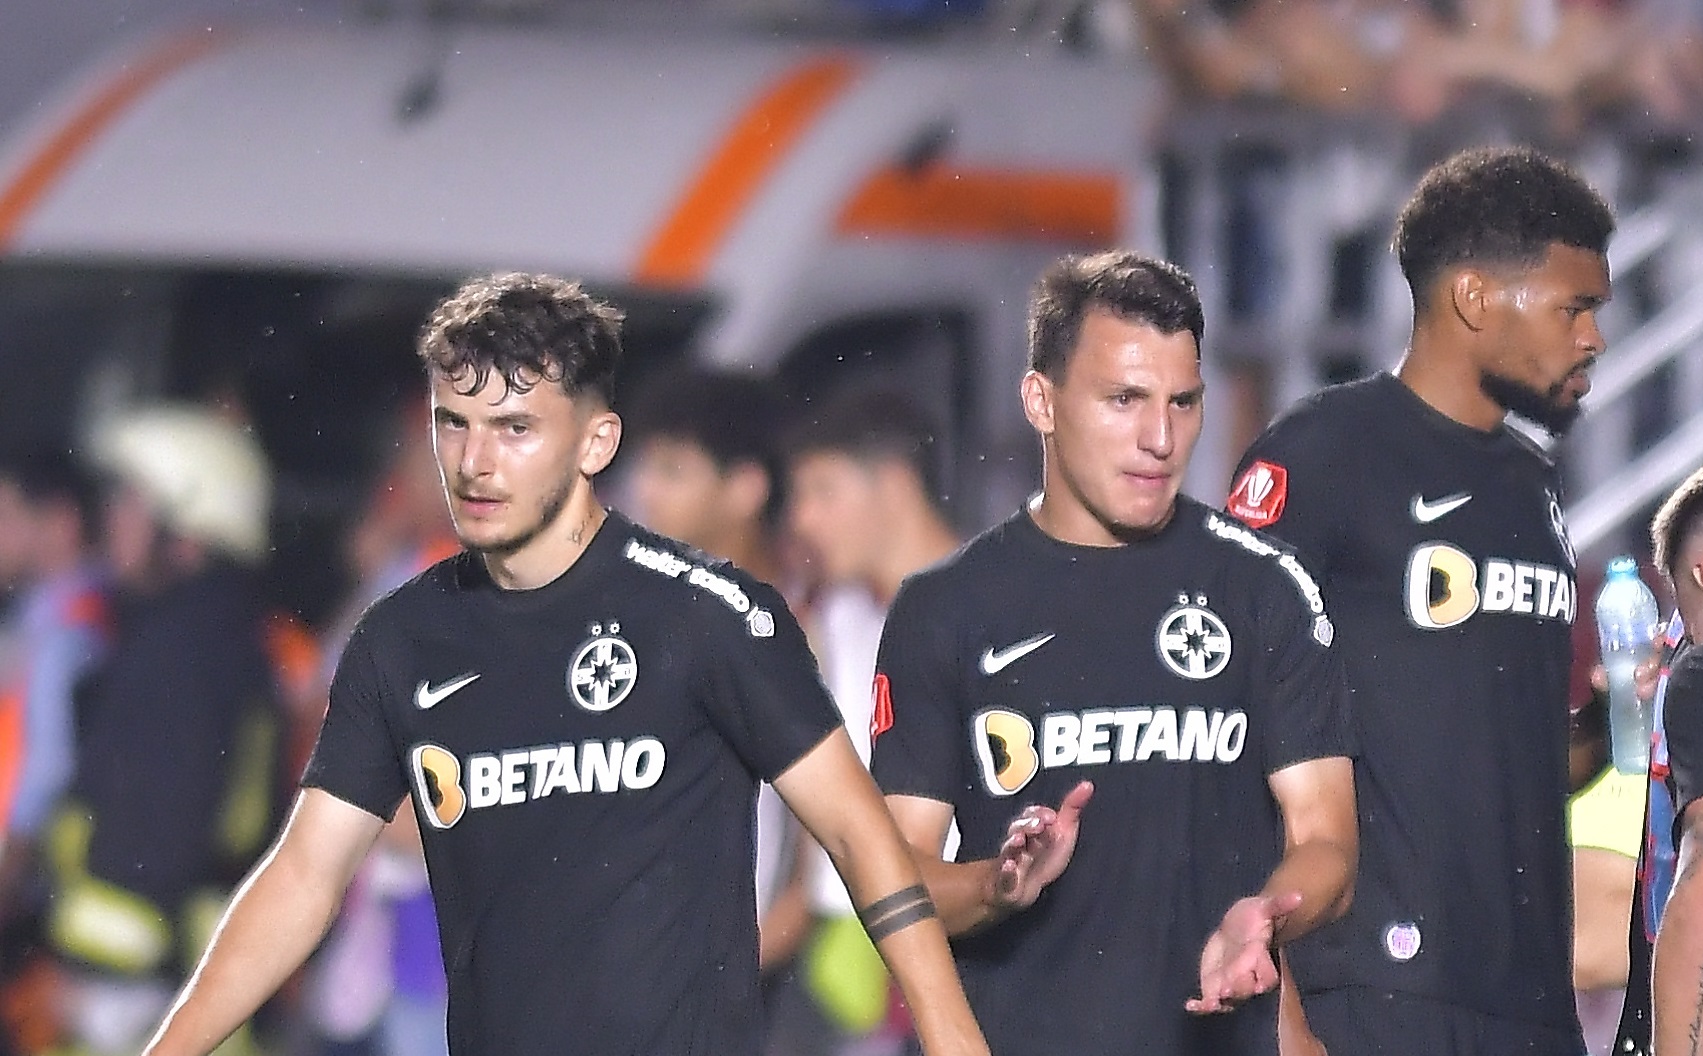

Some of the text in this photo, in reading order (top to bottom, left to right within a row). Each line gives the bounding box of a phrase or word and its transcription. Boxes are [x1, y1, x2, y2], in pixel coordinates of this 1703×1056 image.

[1482, 560, 1578, 625] BETA
[1043, 709, 1248, 769] BETANO
[470, 739, 666, 809] BETANO
